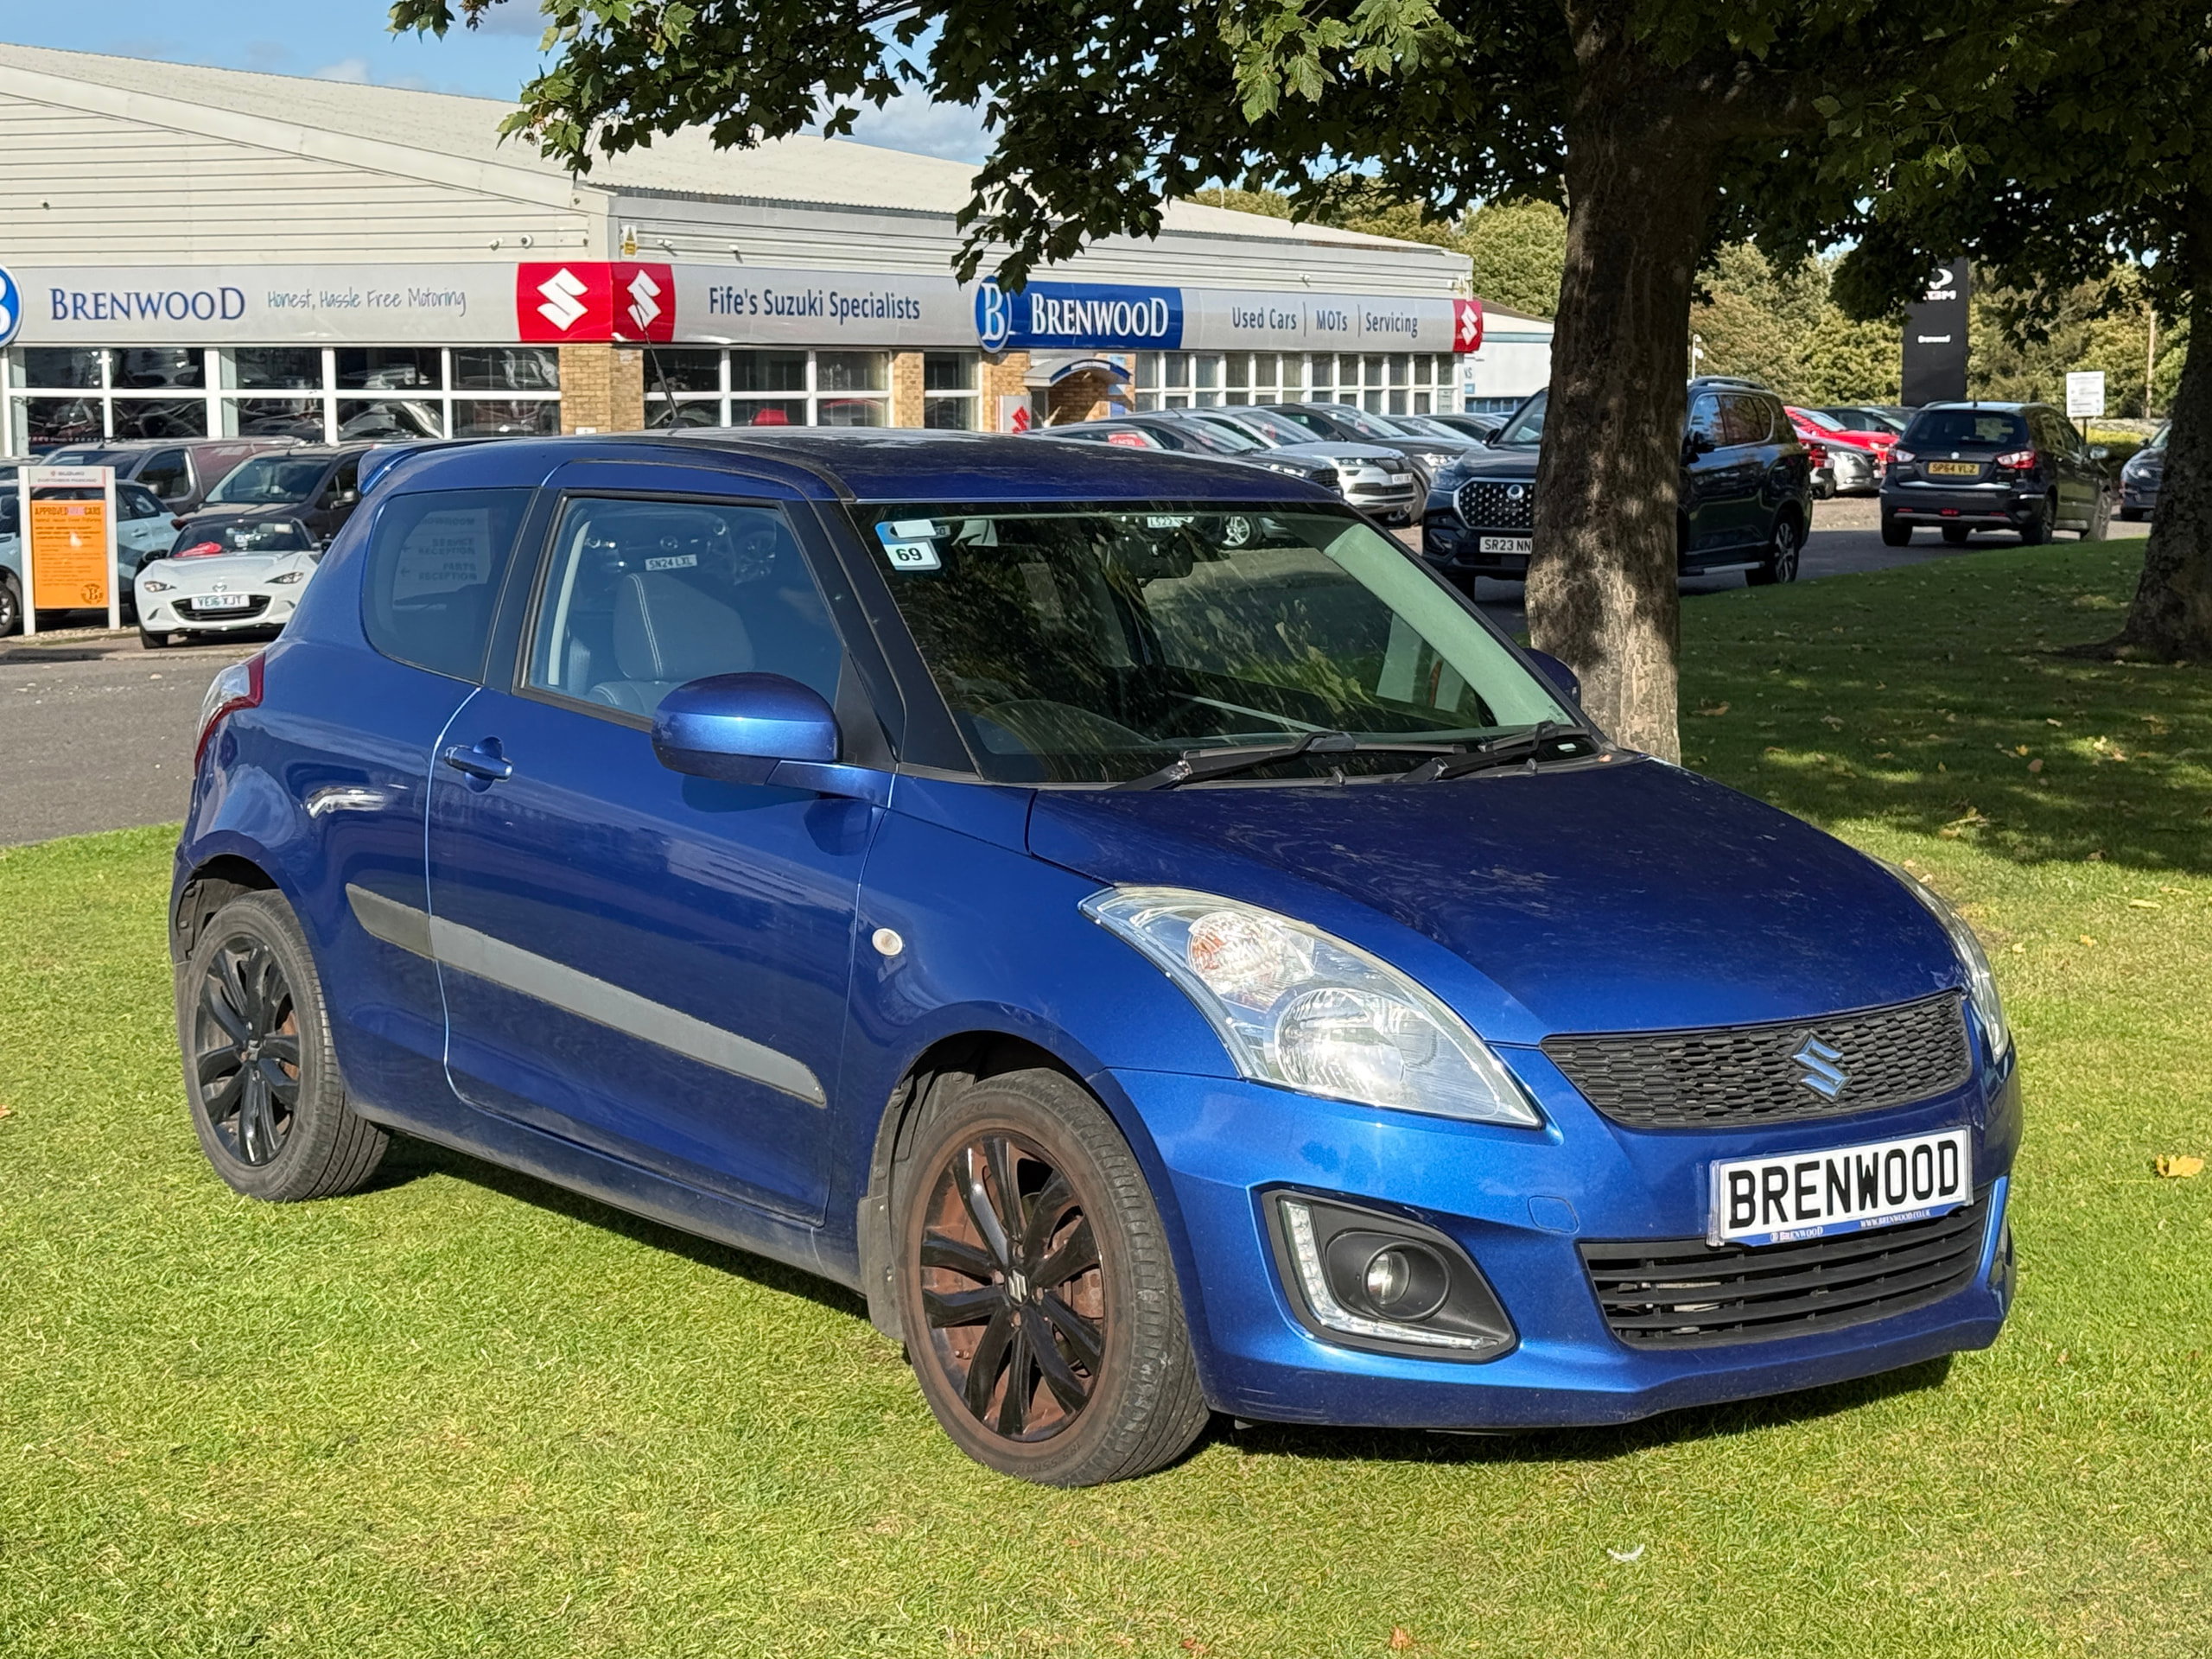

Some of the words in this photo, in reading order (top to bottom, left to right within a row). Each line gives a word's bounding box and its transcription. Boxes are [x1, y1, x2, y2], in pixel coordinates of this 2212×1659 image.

[49, 287, 246, 321] BRENWOOD
[267, 289, 316, 310] Honest,
[320, 287, 361, 308] Hassle
[366, 289, 402, 308] Free
[408, 287, 467, 317] Motoring
[709, 287, 759, 316] Fife's
[764, 289, 823, 319] Suzuki
[829, 290, 921, 325] Specialists
[1030, 292, 1169, 338] BRENWOOD
[1231, 307, 1264, 328] Used
[1269, 308, 1297, 330] Cars
[1316, 310, 1348, 332] MOTs
[1365, 311, 1418, 338] Servicing
[895, 547, 923, 562] 69
[1484, 539, 1514, 551] SR23
[1516, 540, 1531, 551] NN
[1728, 1139, 1959, 1230] BRENWOOD
